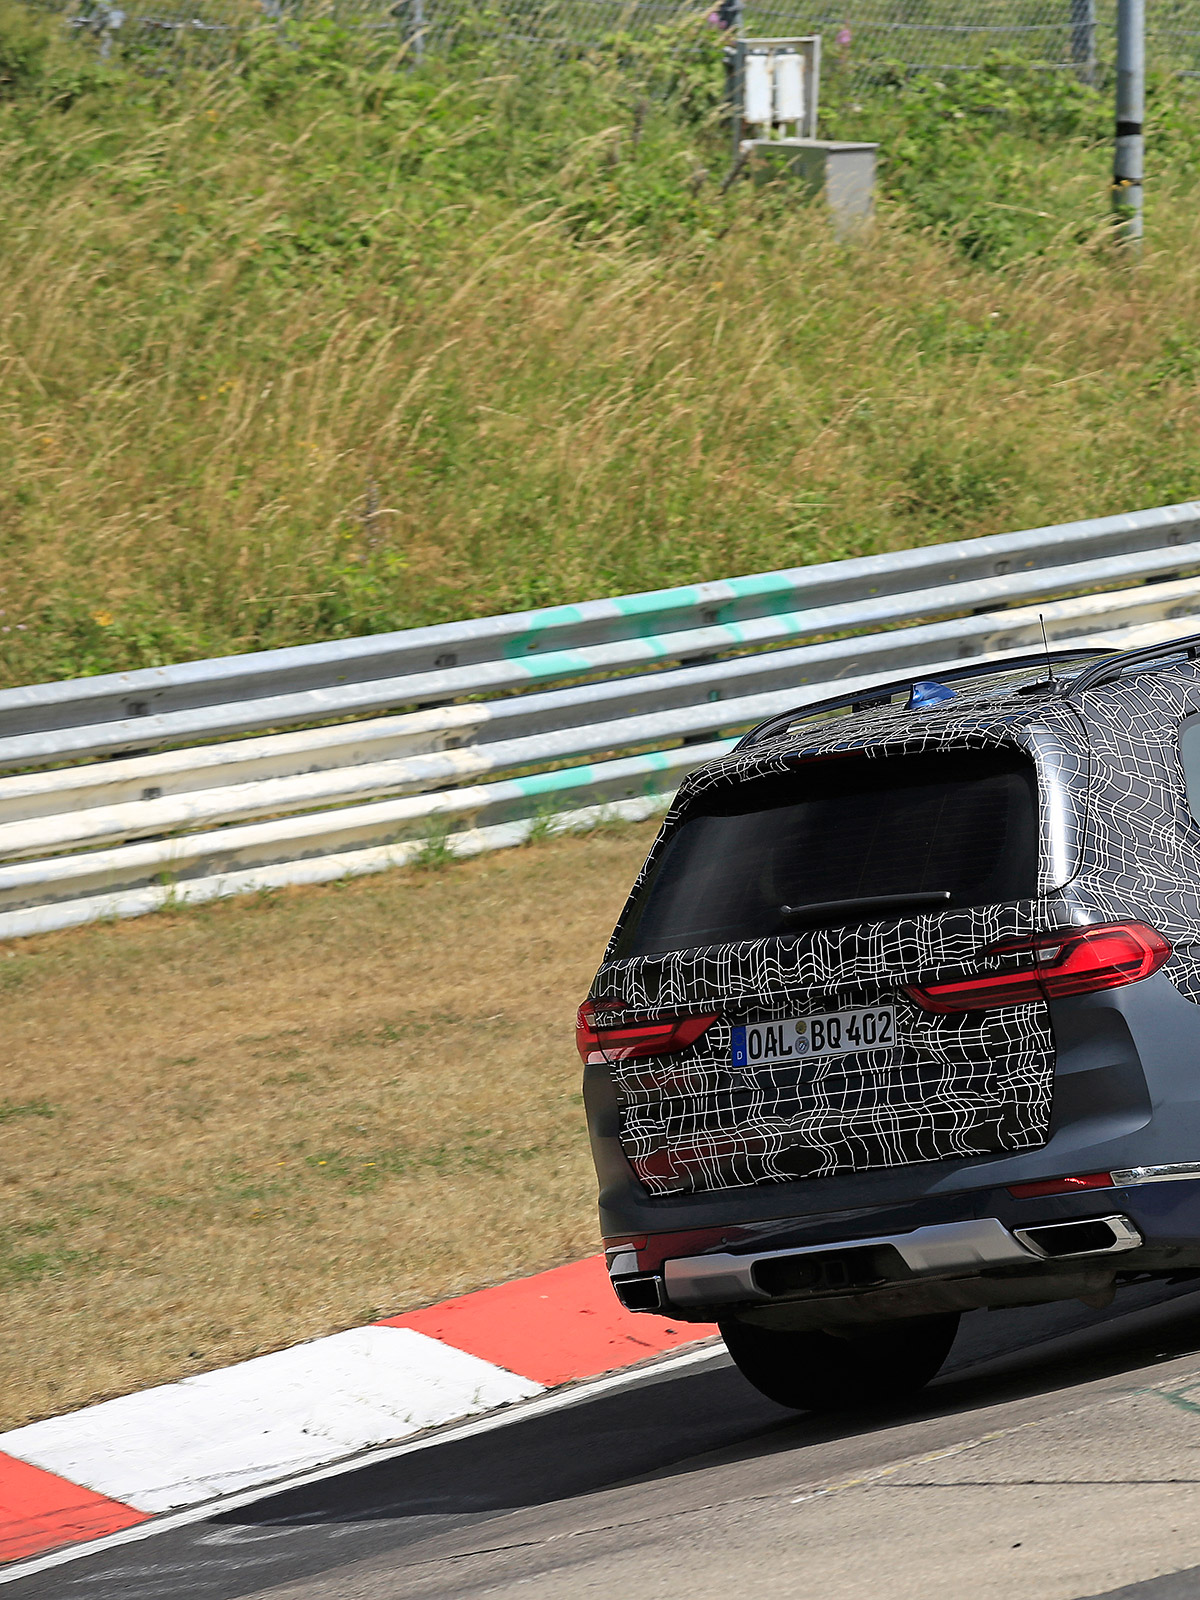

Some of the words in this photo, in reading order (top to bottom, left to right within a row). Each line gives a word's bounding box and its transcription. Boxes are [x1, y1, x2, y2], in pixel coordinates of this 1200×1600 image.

[748, 1026, 792, 1059] OAL
[810, 1019, 841, 1051] BQ
[846, 1012, 892, 1046] 402
[736, 1052, 743, 1060] D
